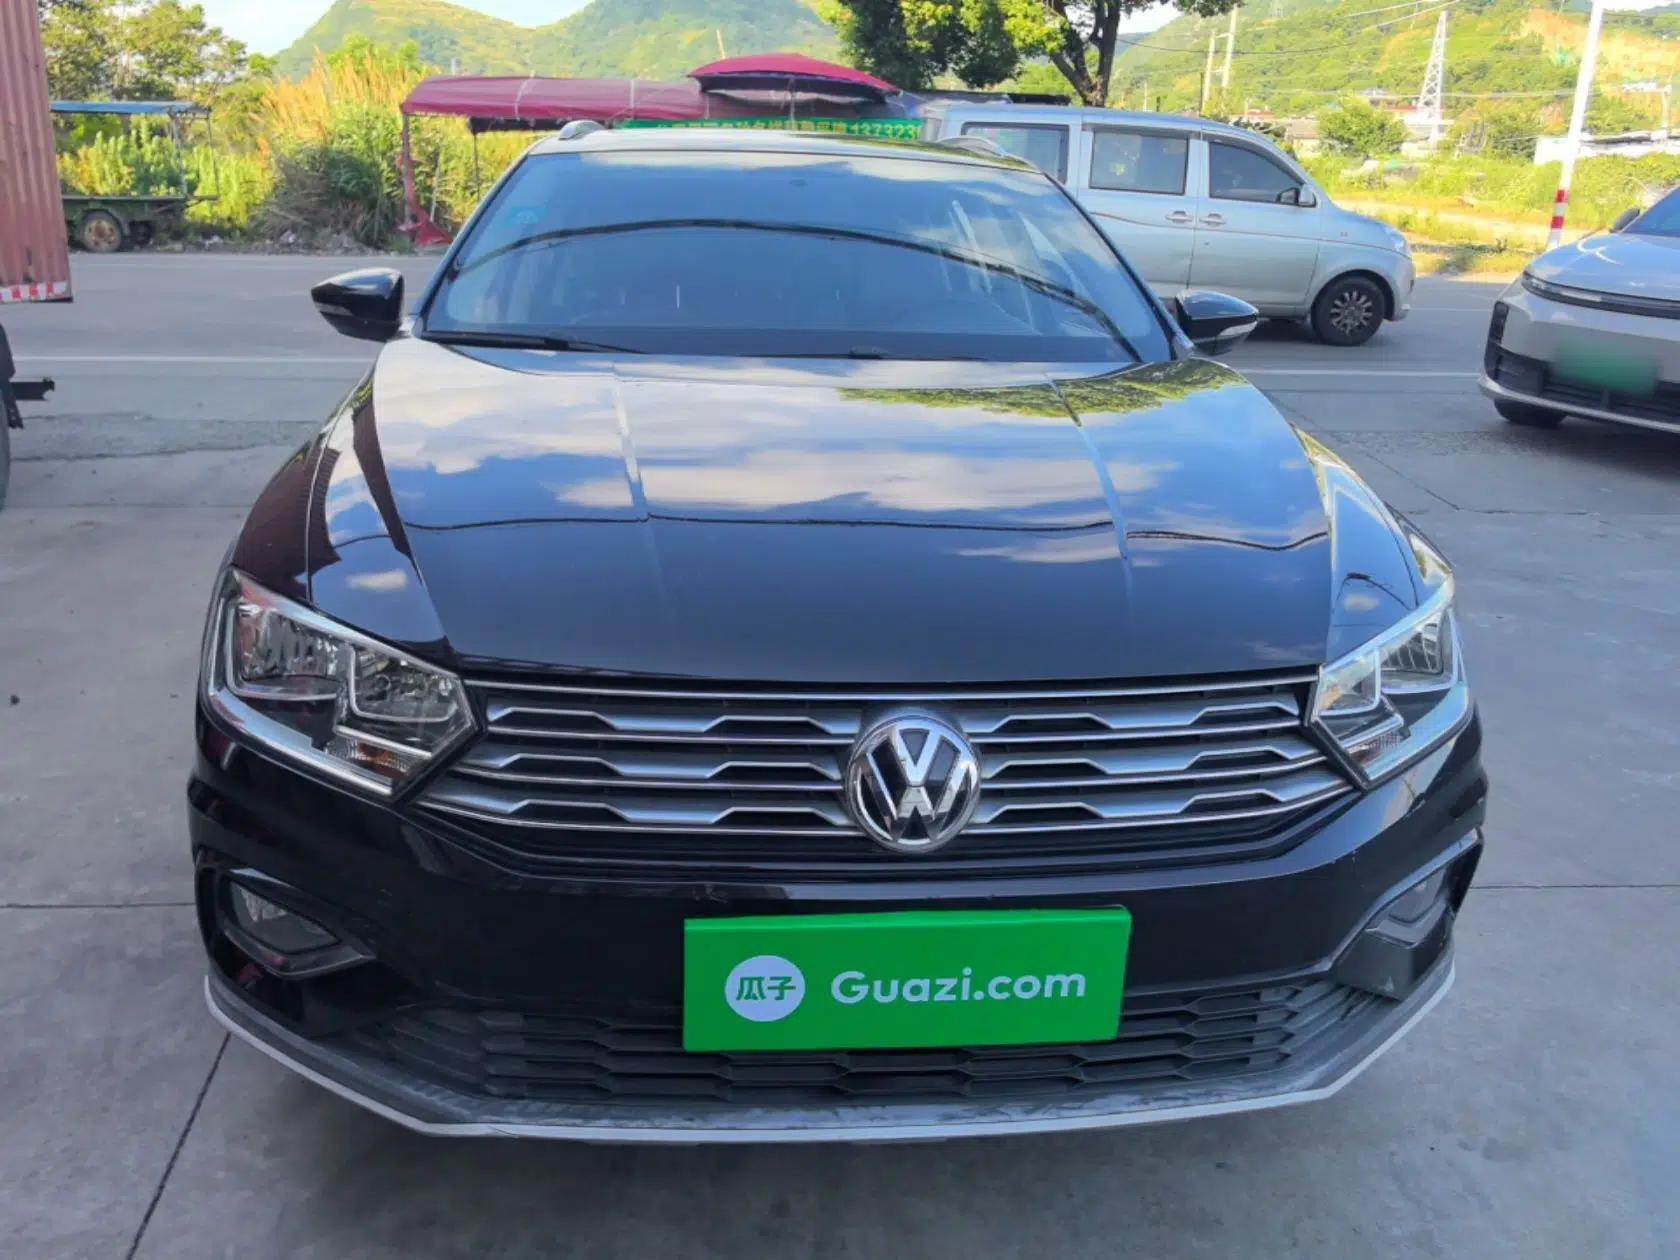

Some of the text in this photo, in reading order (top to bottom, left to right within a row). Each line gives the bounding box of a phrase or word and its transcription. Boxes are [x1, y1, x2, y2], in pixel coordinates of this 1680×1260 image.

[855, 718, 975, 844] VW
[735, 976, 797, 1001] 瓜子
[831, 967, 1086, 1004] Guazi.com
